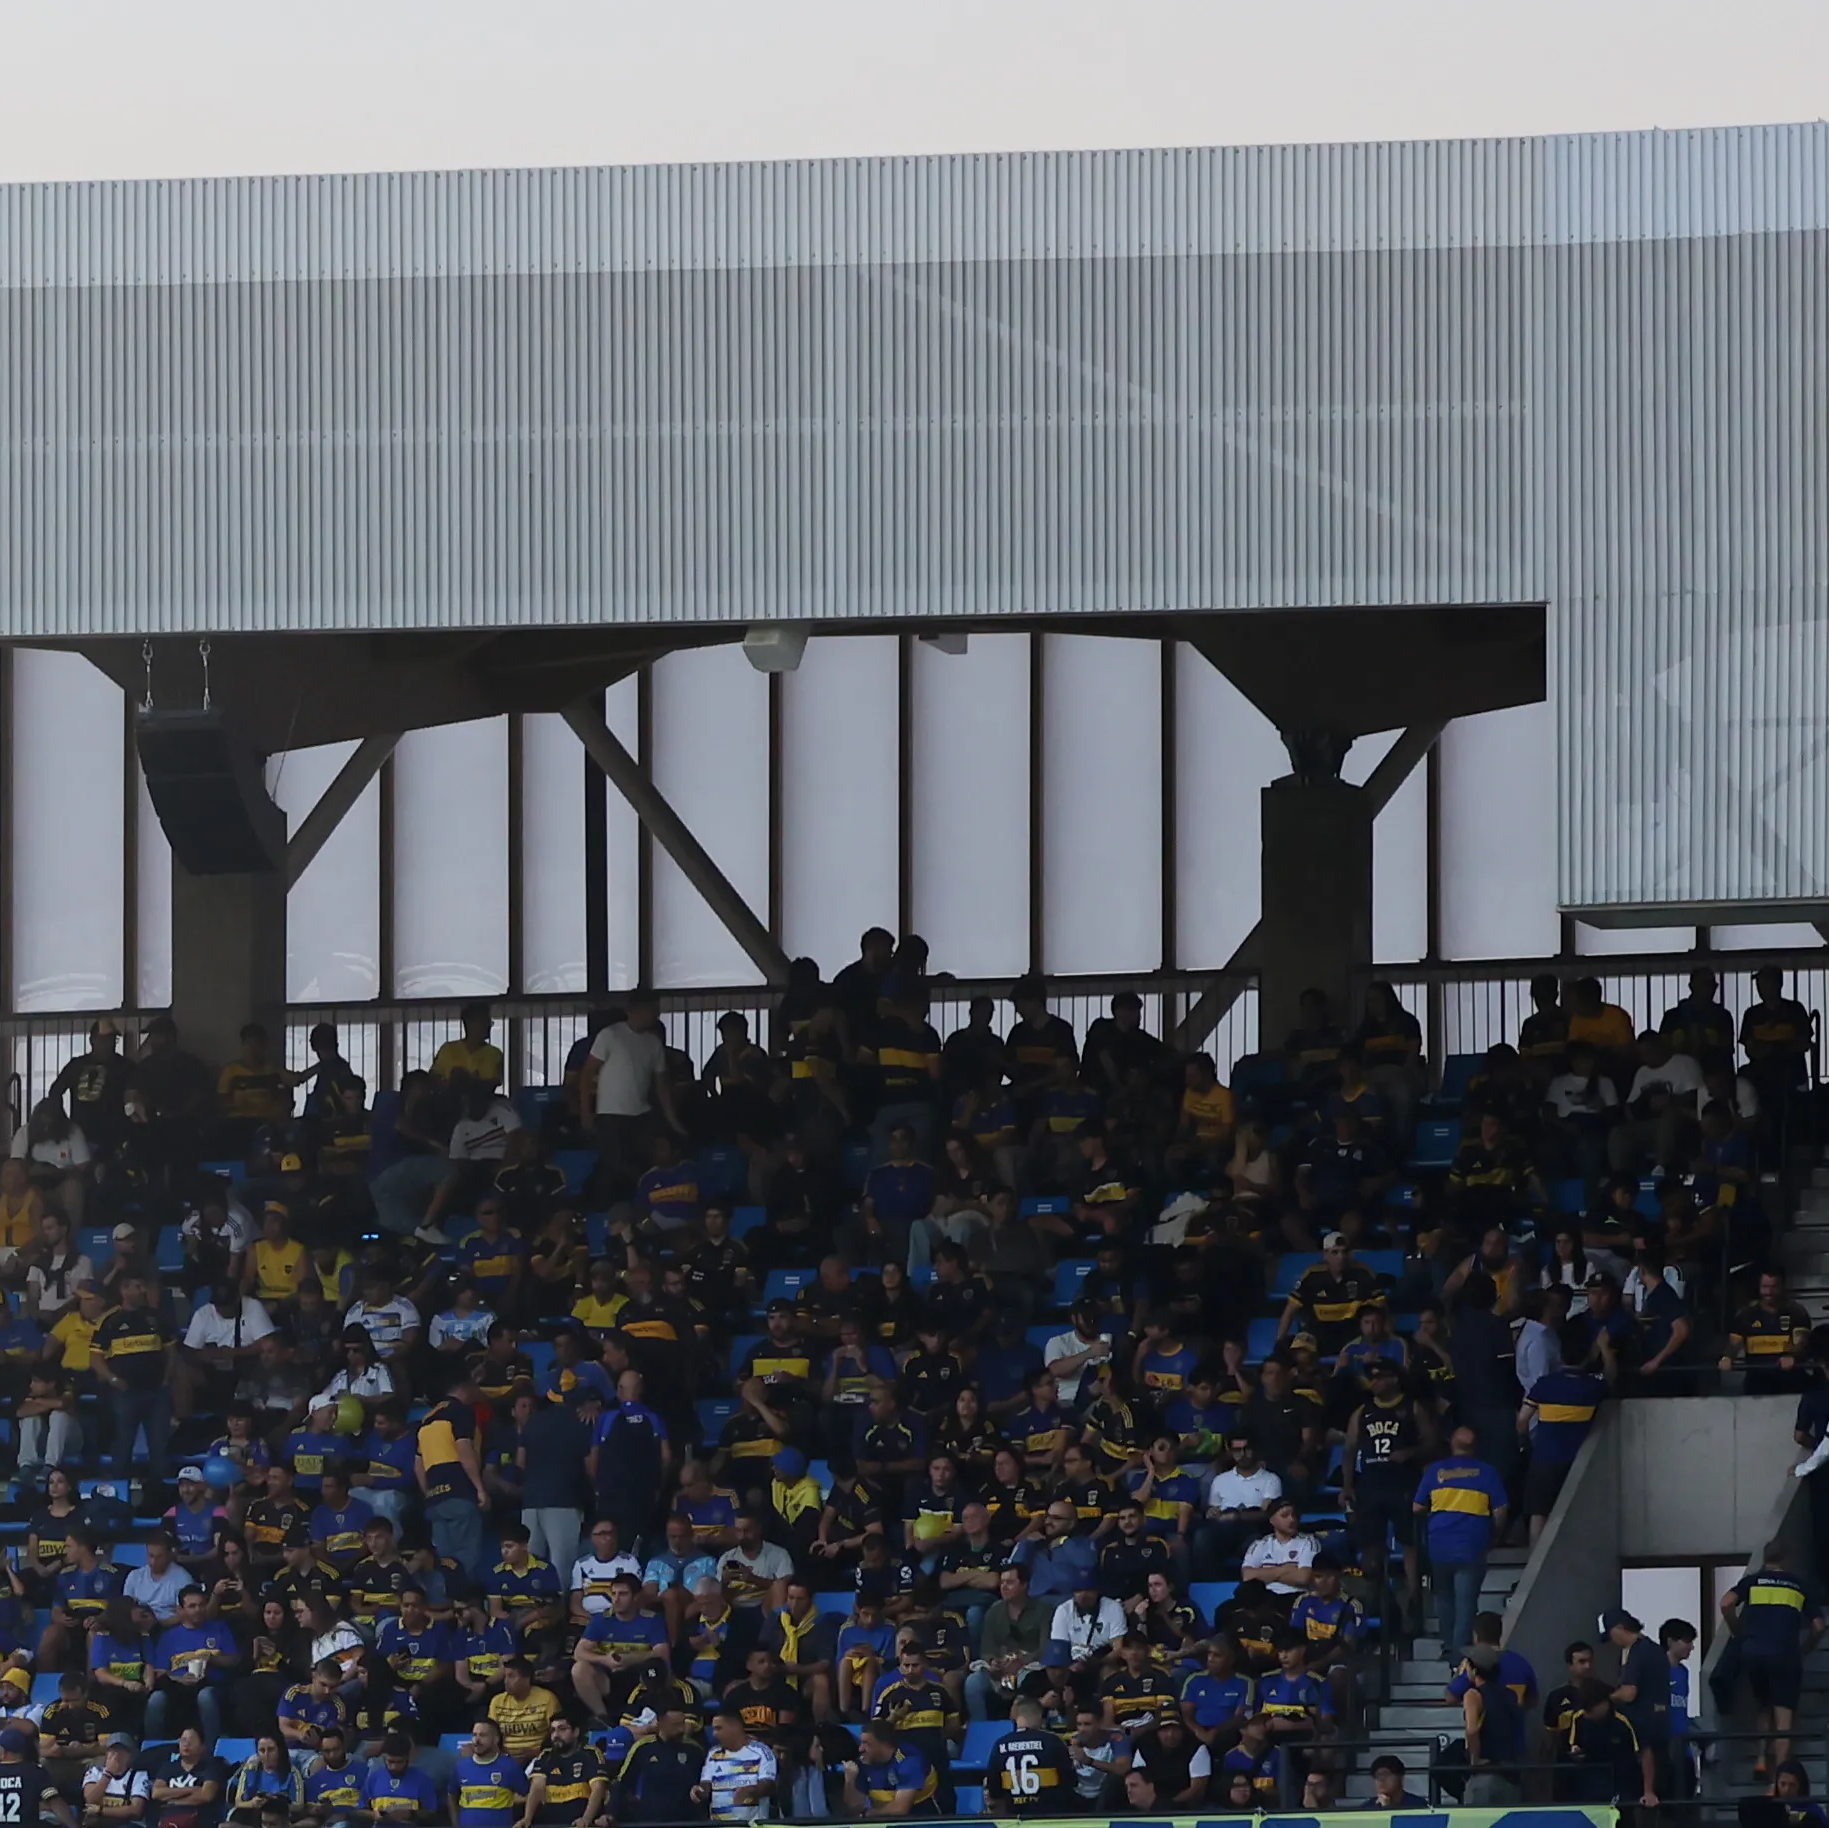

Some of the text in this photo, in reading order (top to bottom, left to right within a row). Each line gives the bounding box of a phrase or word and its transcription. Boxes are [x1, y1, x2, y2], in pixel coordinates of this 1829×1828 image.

[1366, 1421, 1400, 1437] BOCA
[1374, 1438, 1391, 1454] 12
[1010, 1754, 1046, 1795] 16
